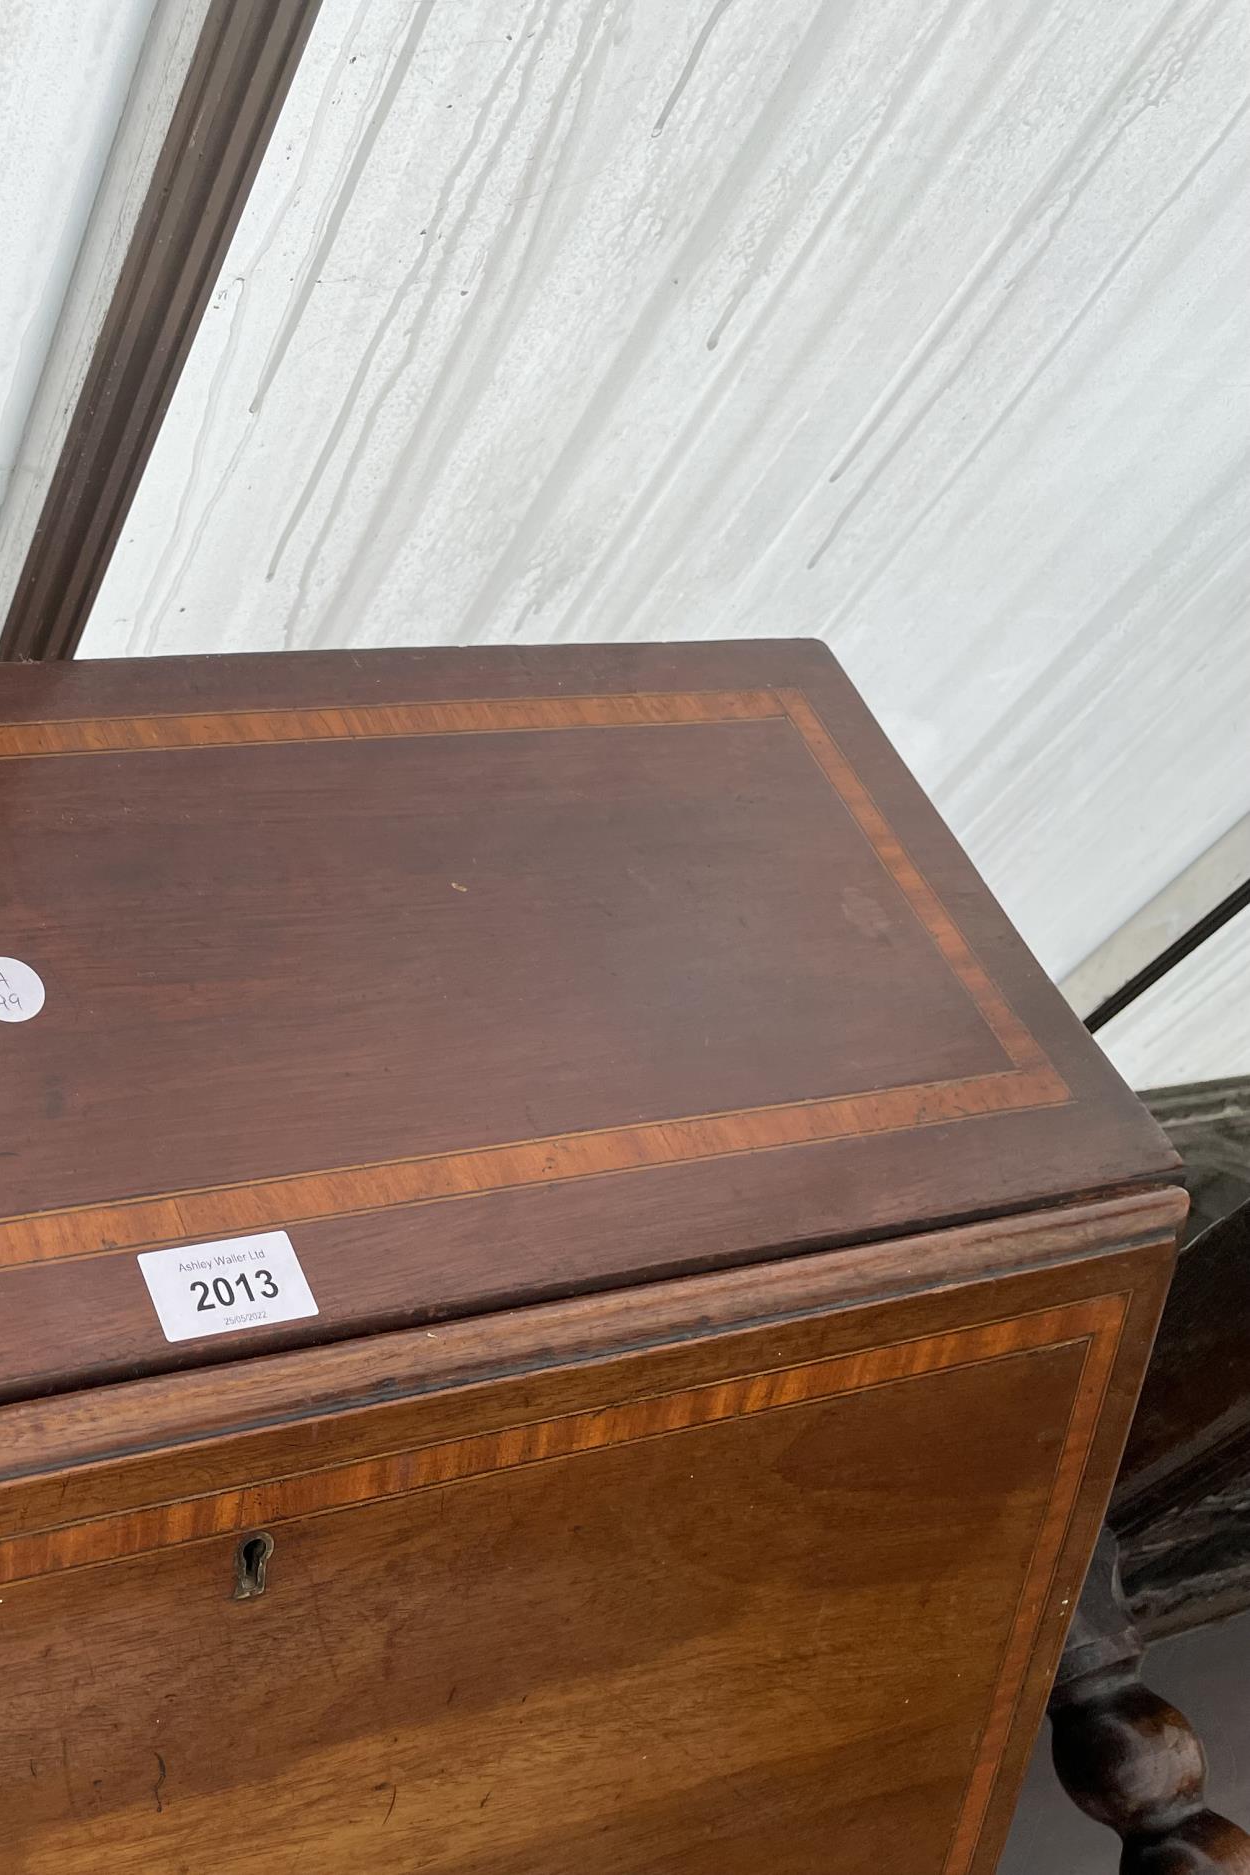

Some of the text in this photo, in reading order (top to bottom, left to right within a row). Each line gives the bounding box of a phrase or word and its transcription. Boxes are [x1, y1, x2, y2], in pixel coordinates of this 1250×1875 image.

[178, 1248, 266, 1273] Ashley Waller Ltd
[190, 1269, 279, 1312] 2013
[224, 1311, 268, 1326] 25/05/2022
